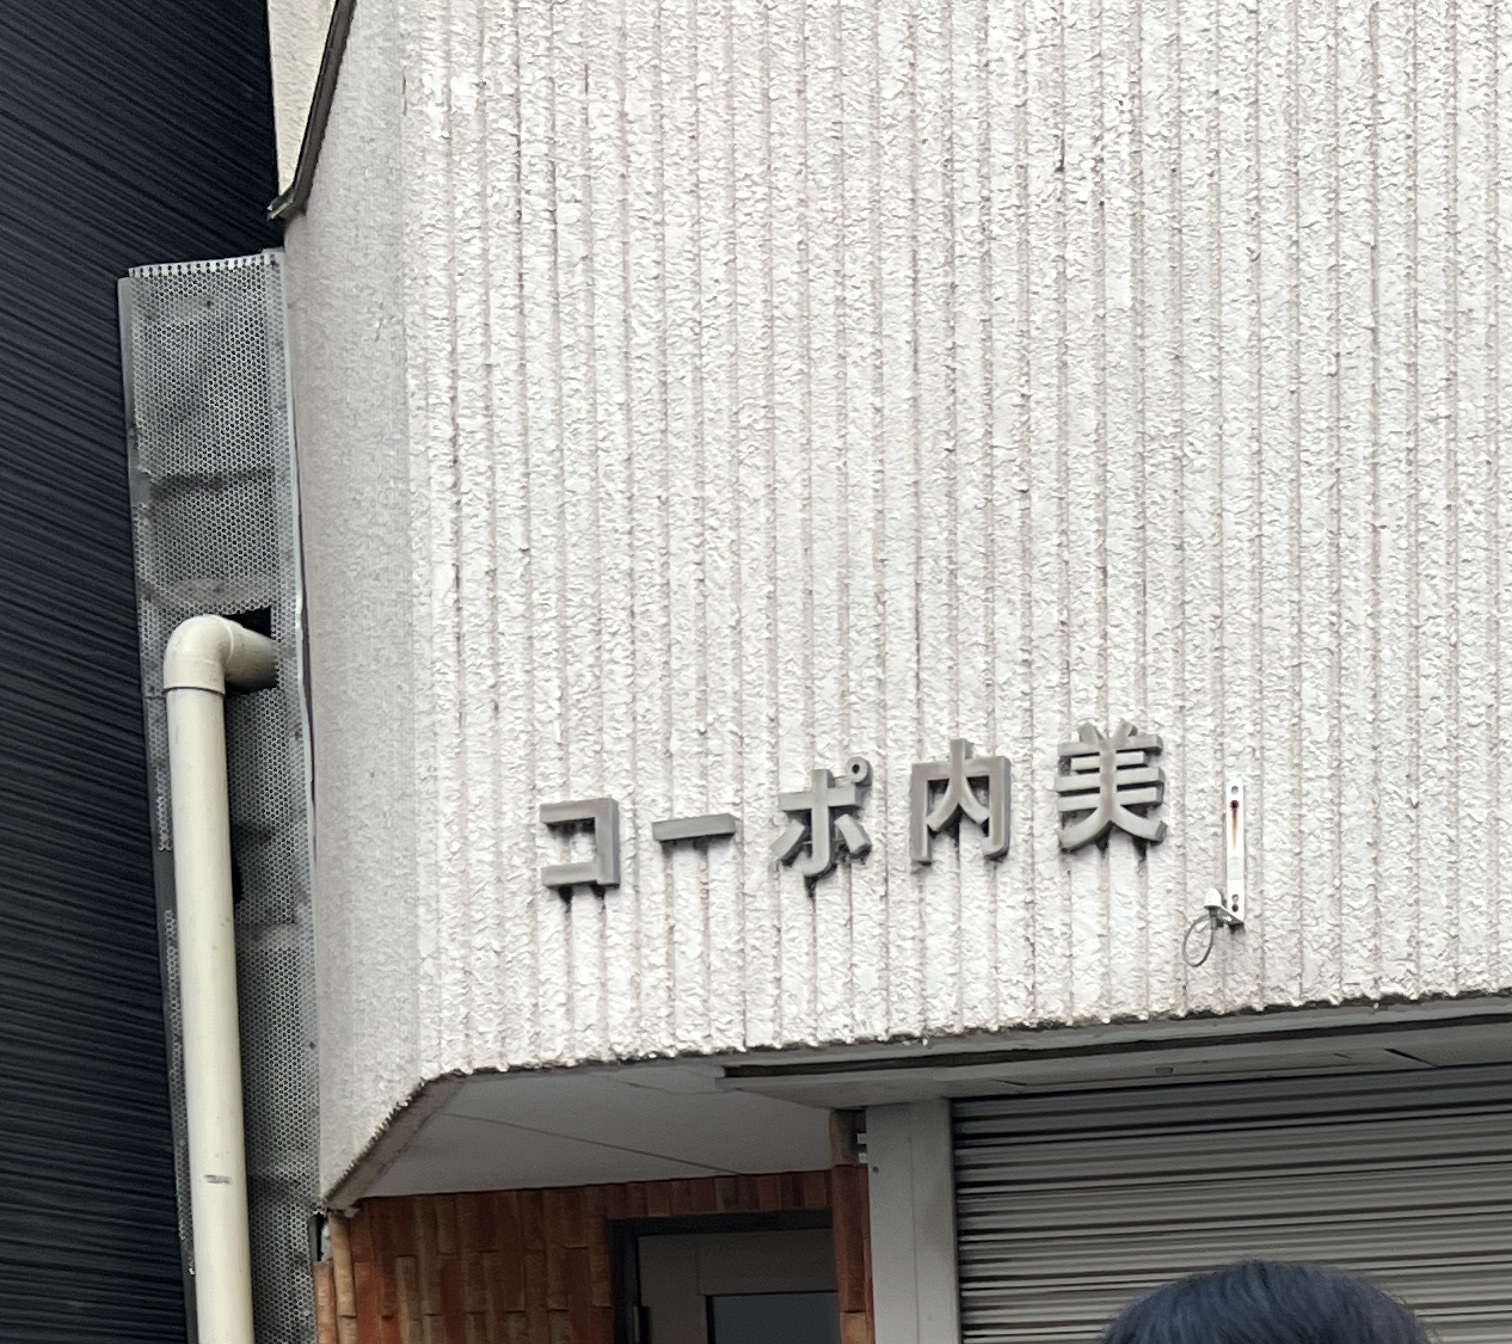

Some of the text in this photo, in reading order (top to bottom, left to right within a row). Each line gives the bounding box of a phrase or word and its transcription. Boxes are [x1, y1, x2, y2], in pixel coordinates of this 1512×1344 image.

[540, 718, 1168, 887] コーポ内美
